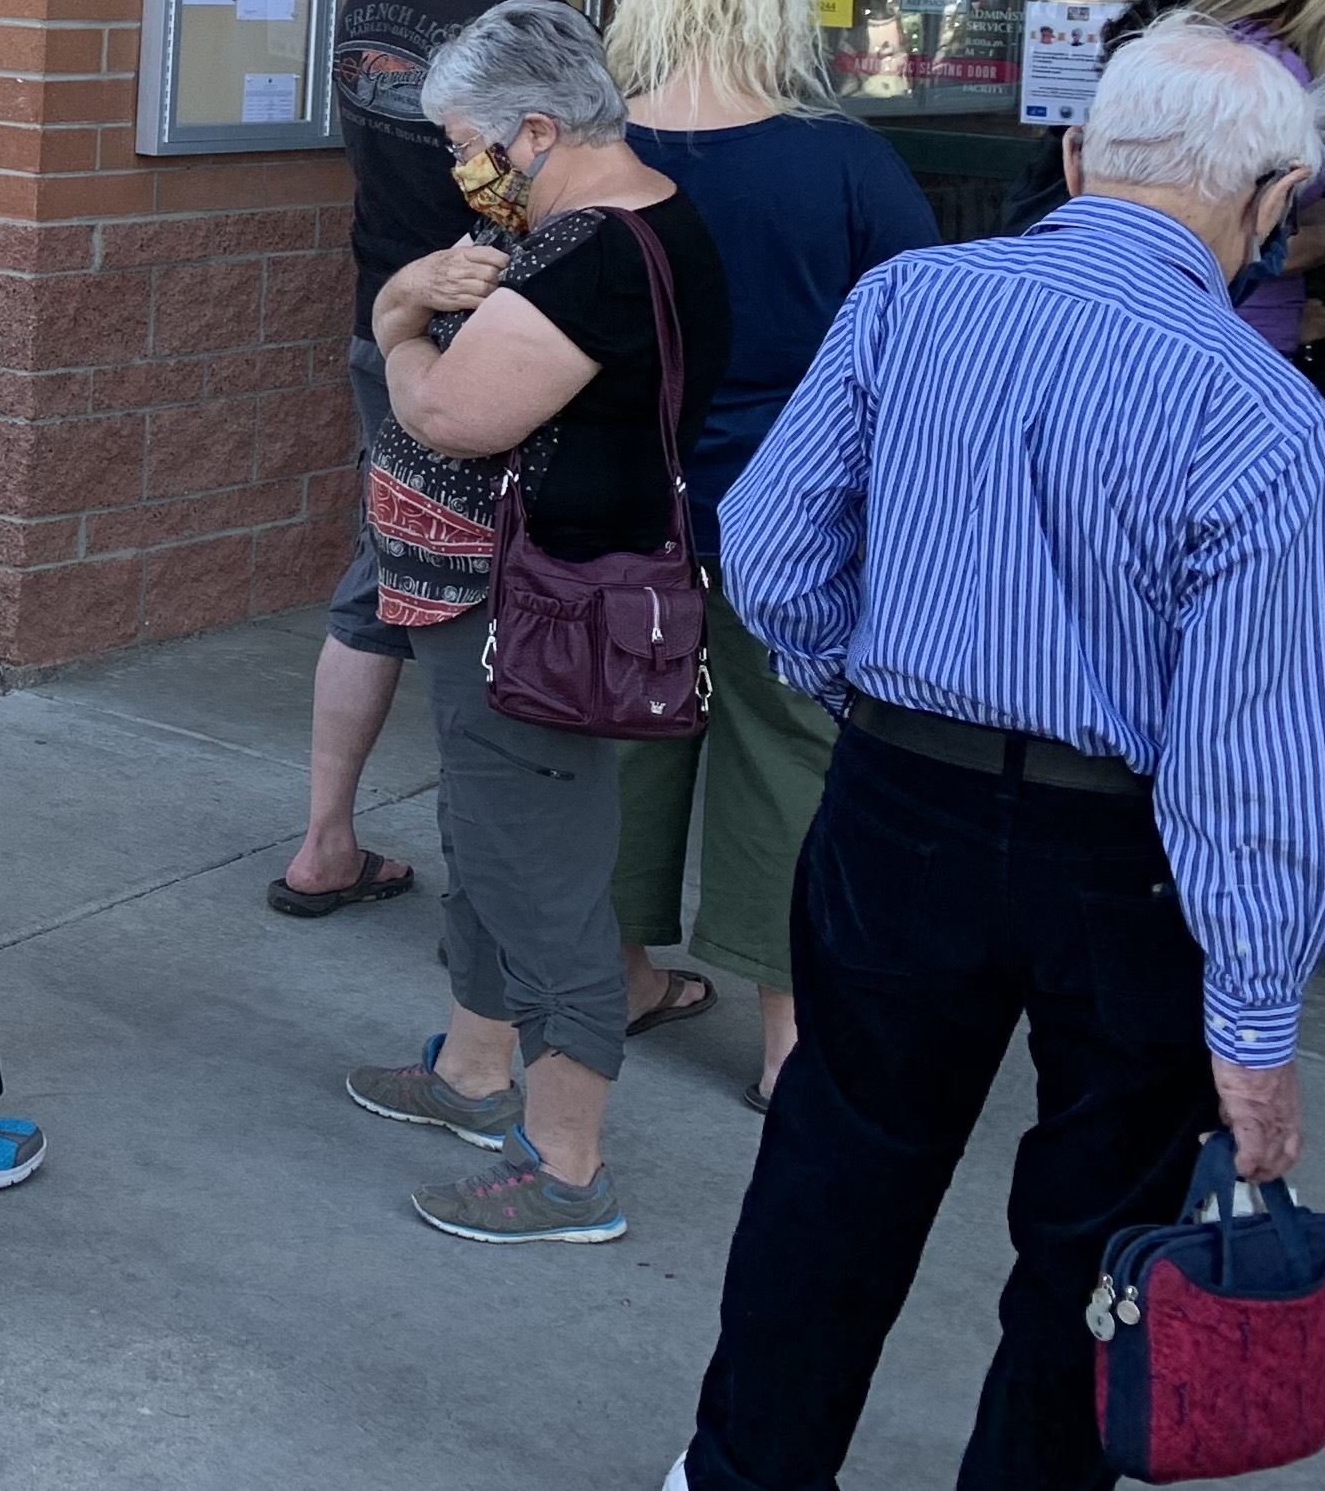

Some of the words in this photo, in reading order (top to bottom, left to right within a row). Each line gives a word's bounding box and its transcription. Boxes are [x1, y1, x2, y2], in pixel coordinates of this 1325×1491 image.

[345, 3, 414, 31] FRENCH
[966, 21, 1014, 32] SERVICE
[967, 65, 997, 79] DOOR
